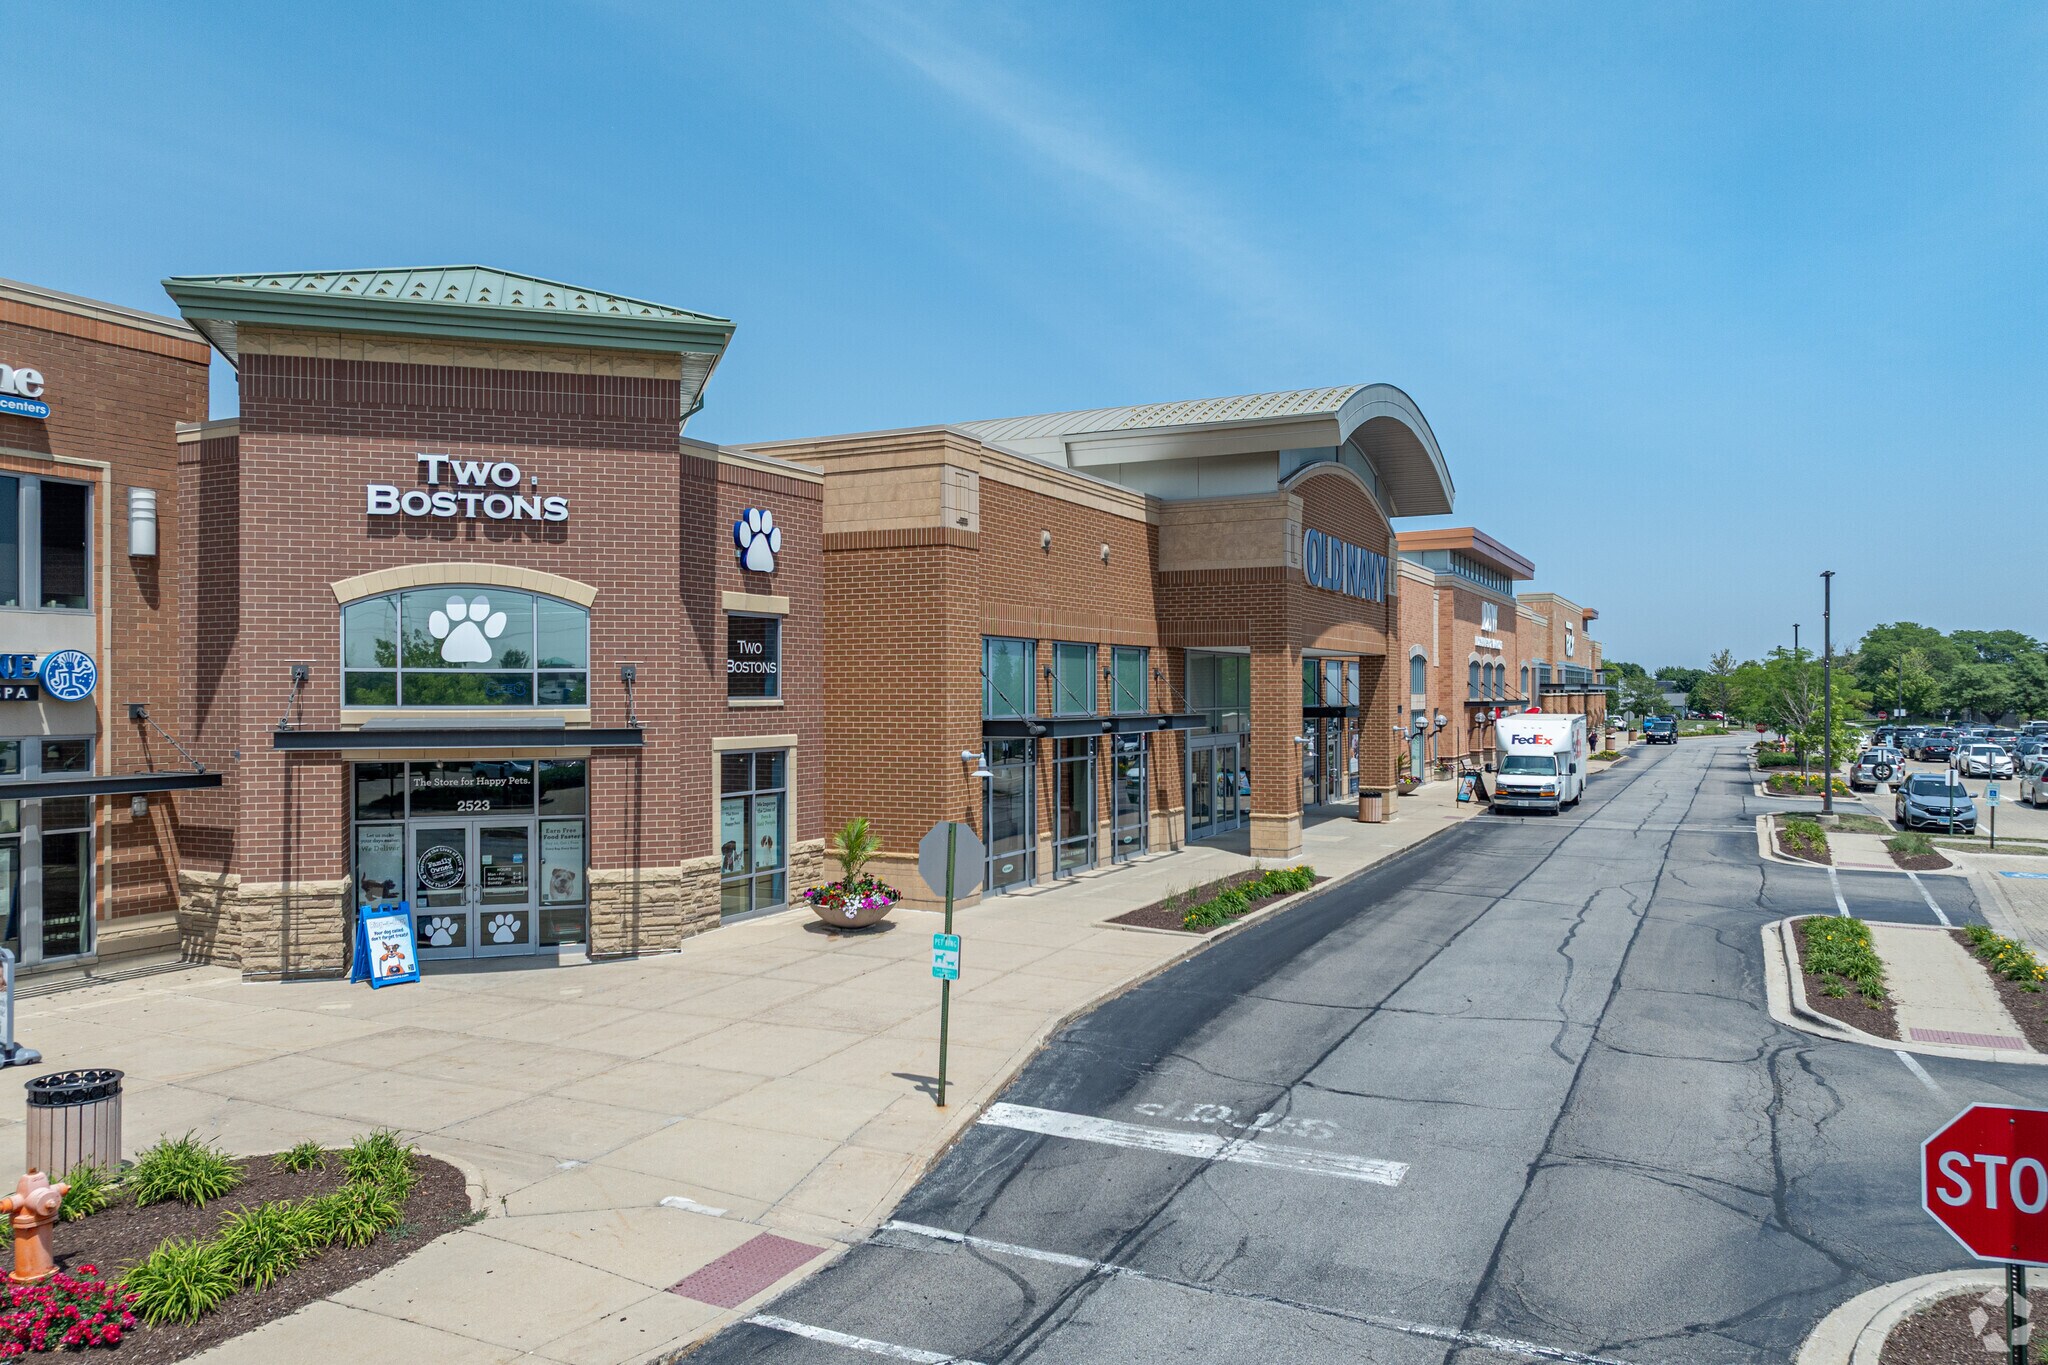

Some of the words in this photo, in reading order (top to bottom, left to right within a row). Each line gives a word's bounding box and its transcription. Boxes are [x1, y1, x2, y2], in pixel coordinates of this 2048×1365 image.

[0, 399, 46, 415] centers
[1302, 527, 1343, 592] OLD
[1342, 541, 1388, 603] NAVY
[0, 687, 28, 699] PA
[1511, 734, 1553, 745] FedEx
[413, 778, 432, 787] The
[433, 778, 459, 787] Store
[460, 776, 475, 786] for
[475, 776, 507, 787] Happy
[508, 776, 531, 785] Pets.
[457, 800, 490, 812] 2523
[427, 857, 452, 869] Family
[430, 863, 454, 874] Owned
